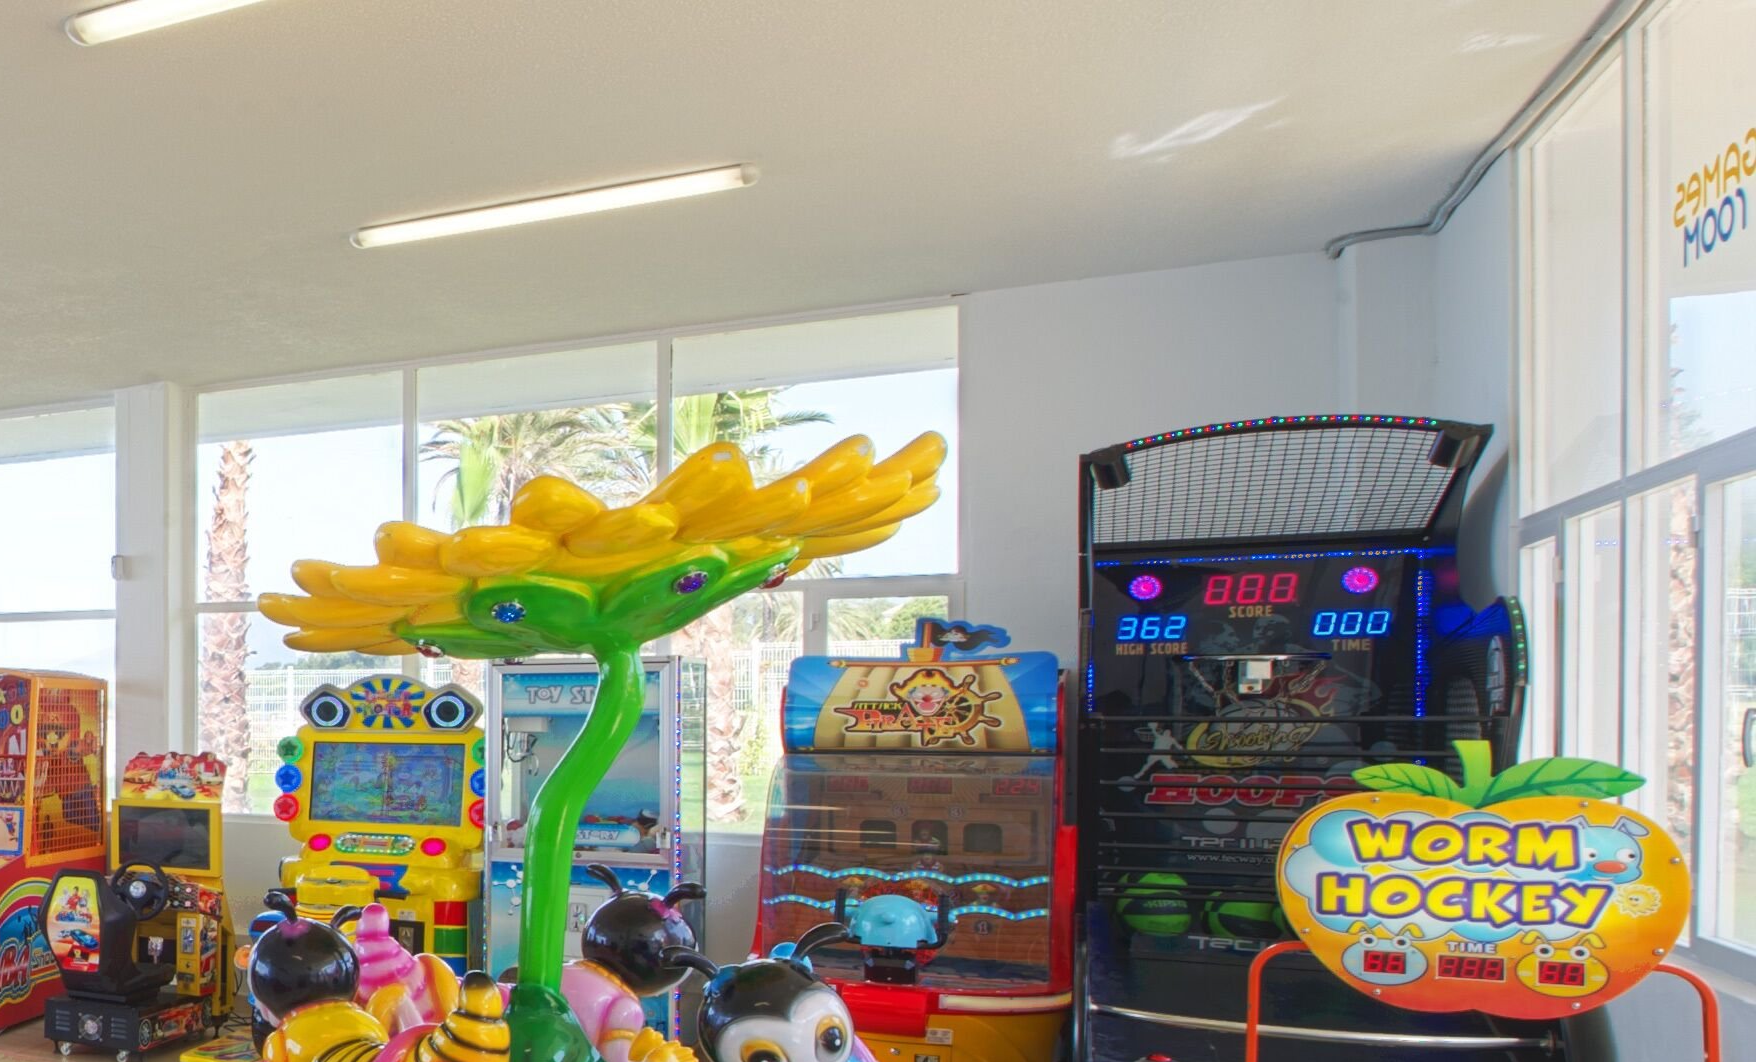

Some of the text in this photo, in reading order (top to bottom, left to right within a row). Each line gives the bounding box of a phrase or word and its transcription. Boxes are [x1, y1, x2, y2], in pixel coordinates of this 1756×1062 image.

[1228, 605, 1274, 618] SCORE
[1117, 615, 1187, 640] 362
[1312, 611, 1391, 636] 000
[1115, 642, 1188, 655] HIGH SCORE
[1331, 638, 1371, 651] TIME
[526, 685, 563, 704] TOY
[1347, 818, 1580, 872] WORM
[1187, 854, 1277, 865] www.tecway.c
[1314, 872, 1614, 929] HOCKEY
[1447, 942, 1497, 954] TIME
